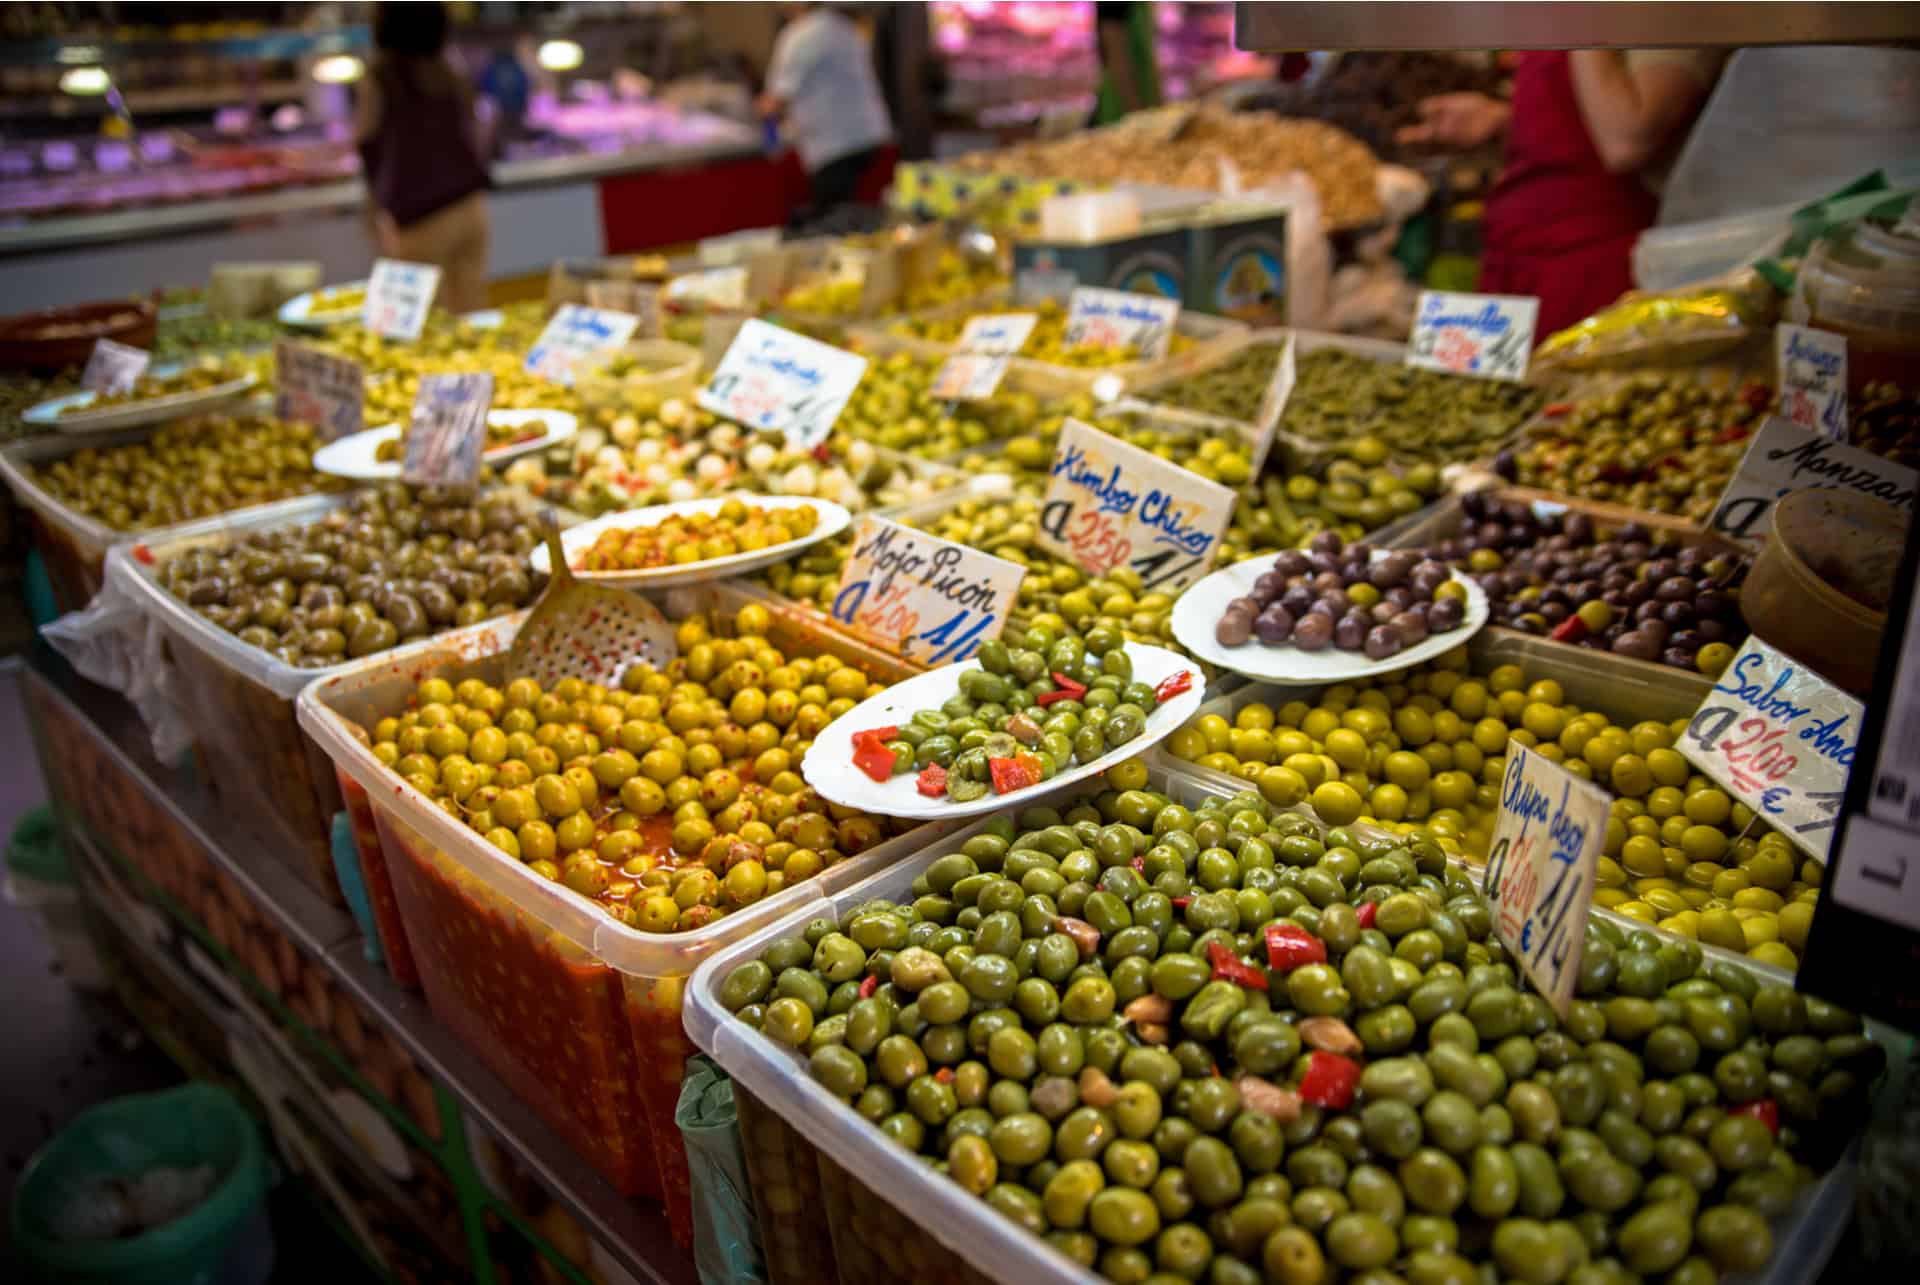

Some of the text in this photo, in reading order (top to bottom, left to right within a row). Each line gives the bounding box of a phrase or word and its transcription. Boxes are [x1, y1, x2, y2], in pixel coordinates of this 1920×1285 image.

[855, 526, 925, 595] Mojo
[1715, 653, 1811, 722] Sabor
[1761, 786, 1792, 814] €
[1536, 864, 1582, 993] 1/4
